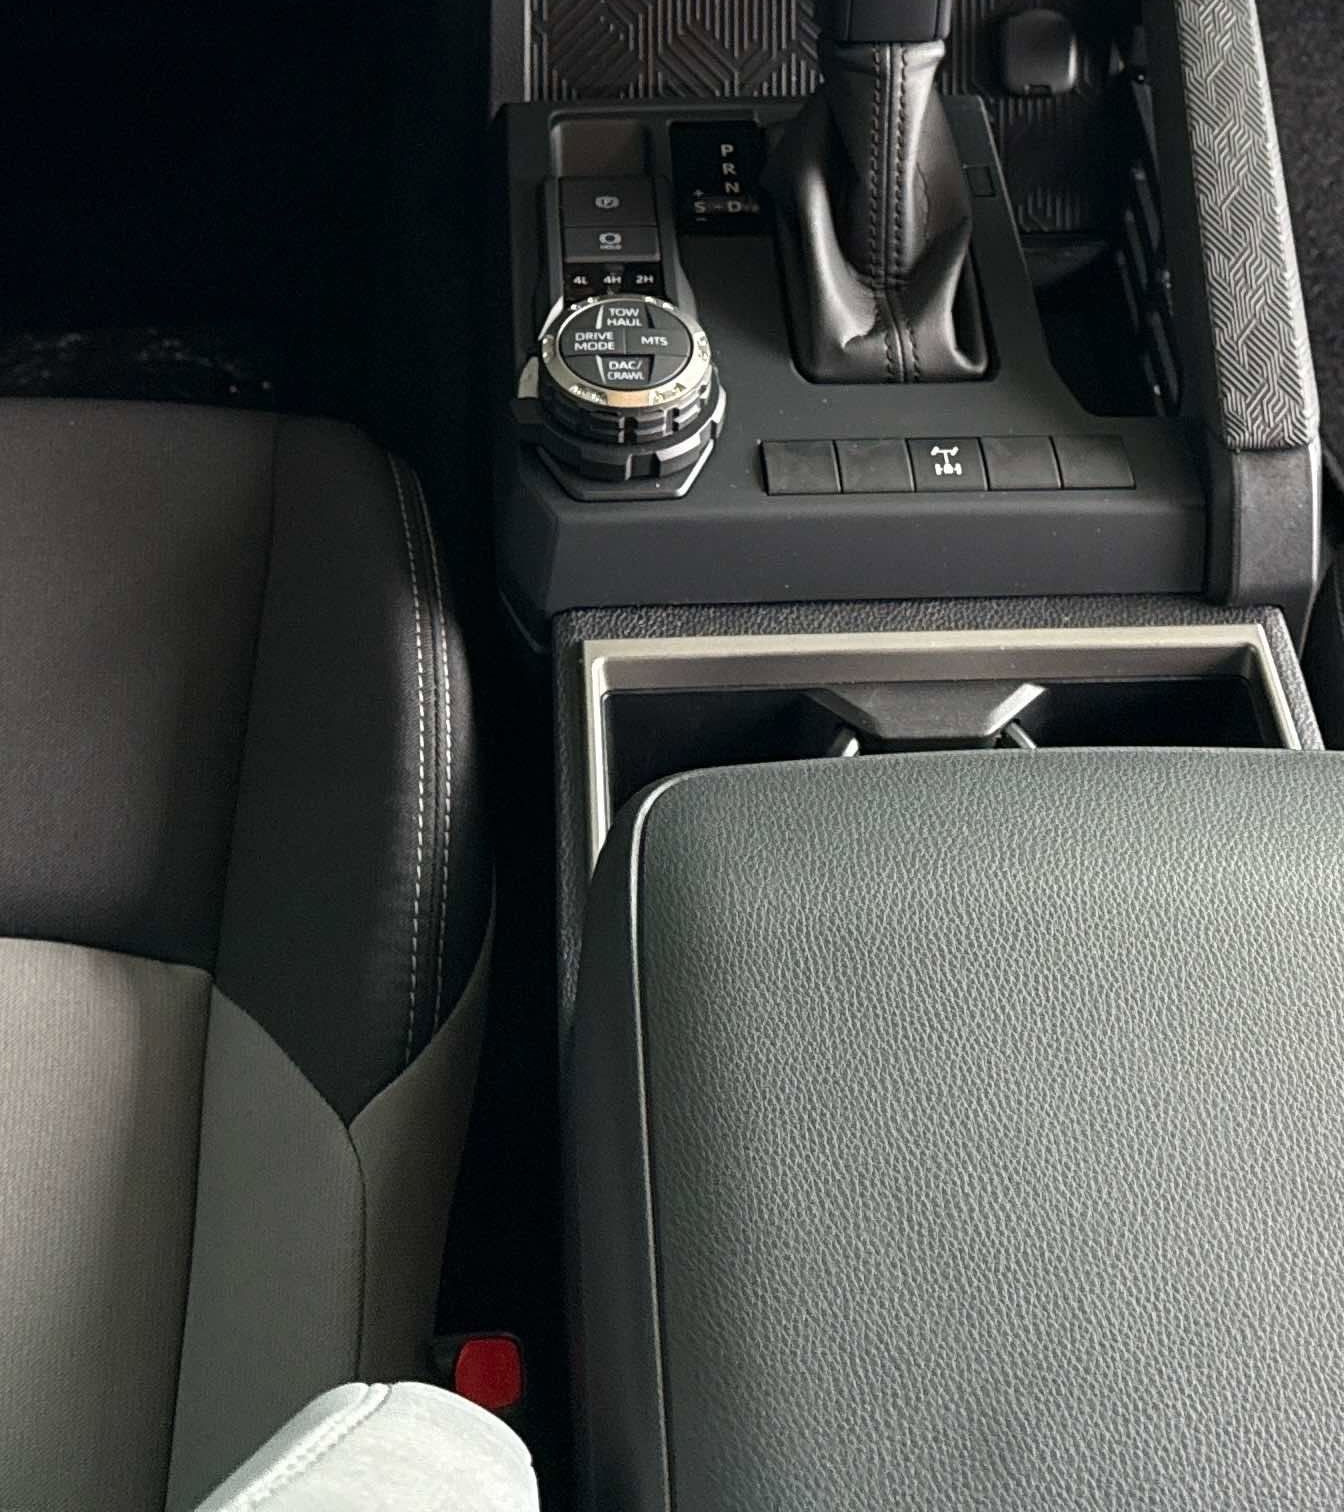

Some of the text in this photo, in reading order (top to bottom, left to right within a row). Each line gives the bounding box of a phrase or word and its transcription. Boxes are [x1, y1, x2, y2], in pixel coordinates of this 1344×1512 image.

[720, 143, 735, 158] P
[722, 162, 737, 176] R
[724, 181, 740, 193] N
[727, 200, 743, 213] D
[573, 274, 654, 285] 4L 4H 2H
[608, 307, 640, 317] TOW
[606, 317, 643, 327] HAUL
[574, 331, 614, 341] DRIVE
[640, 335, 668, 346] MTS
[574, 341, 616, 351] MODE
[608, 360, 643, 370] DAC/
[607, 370, 645, 381] CRAWL
